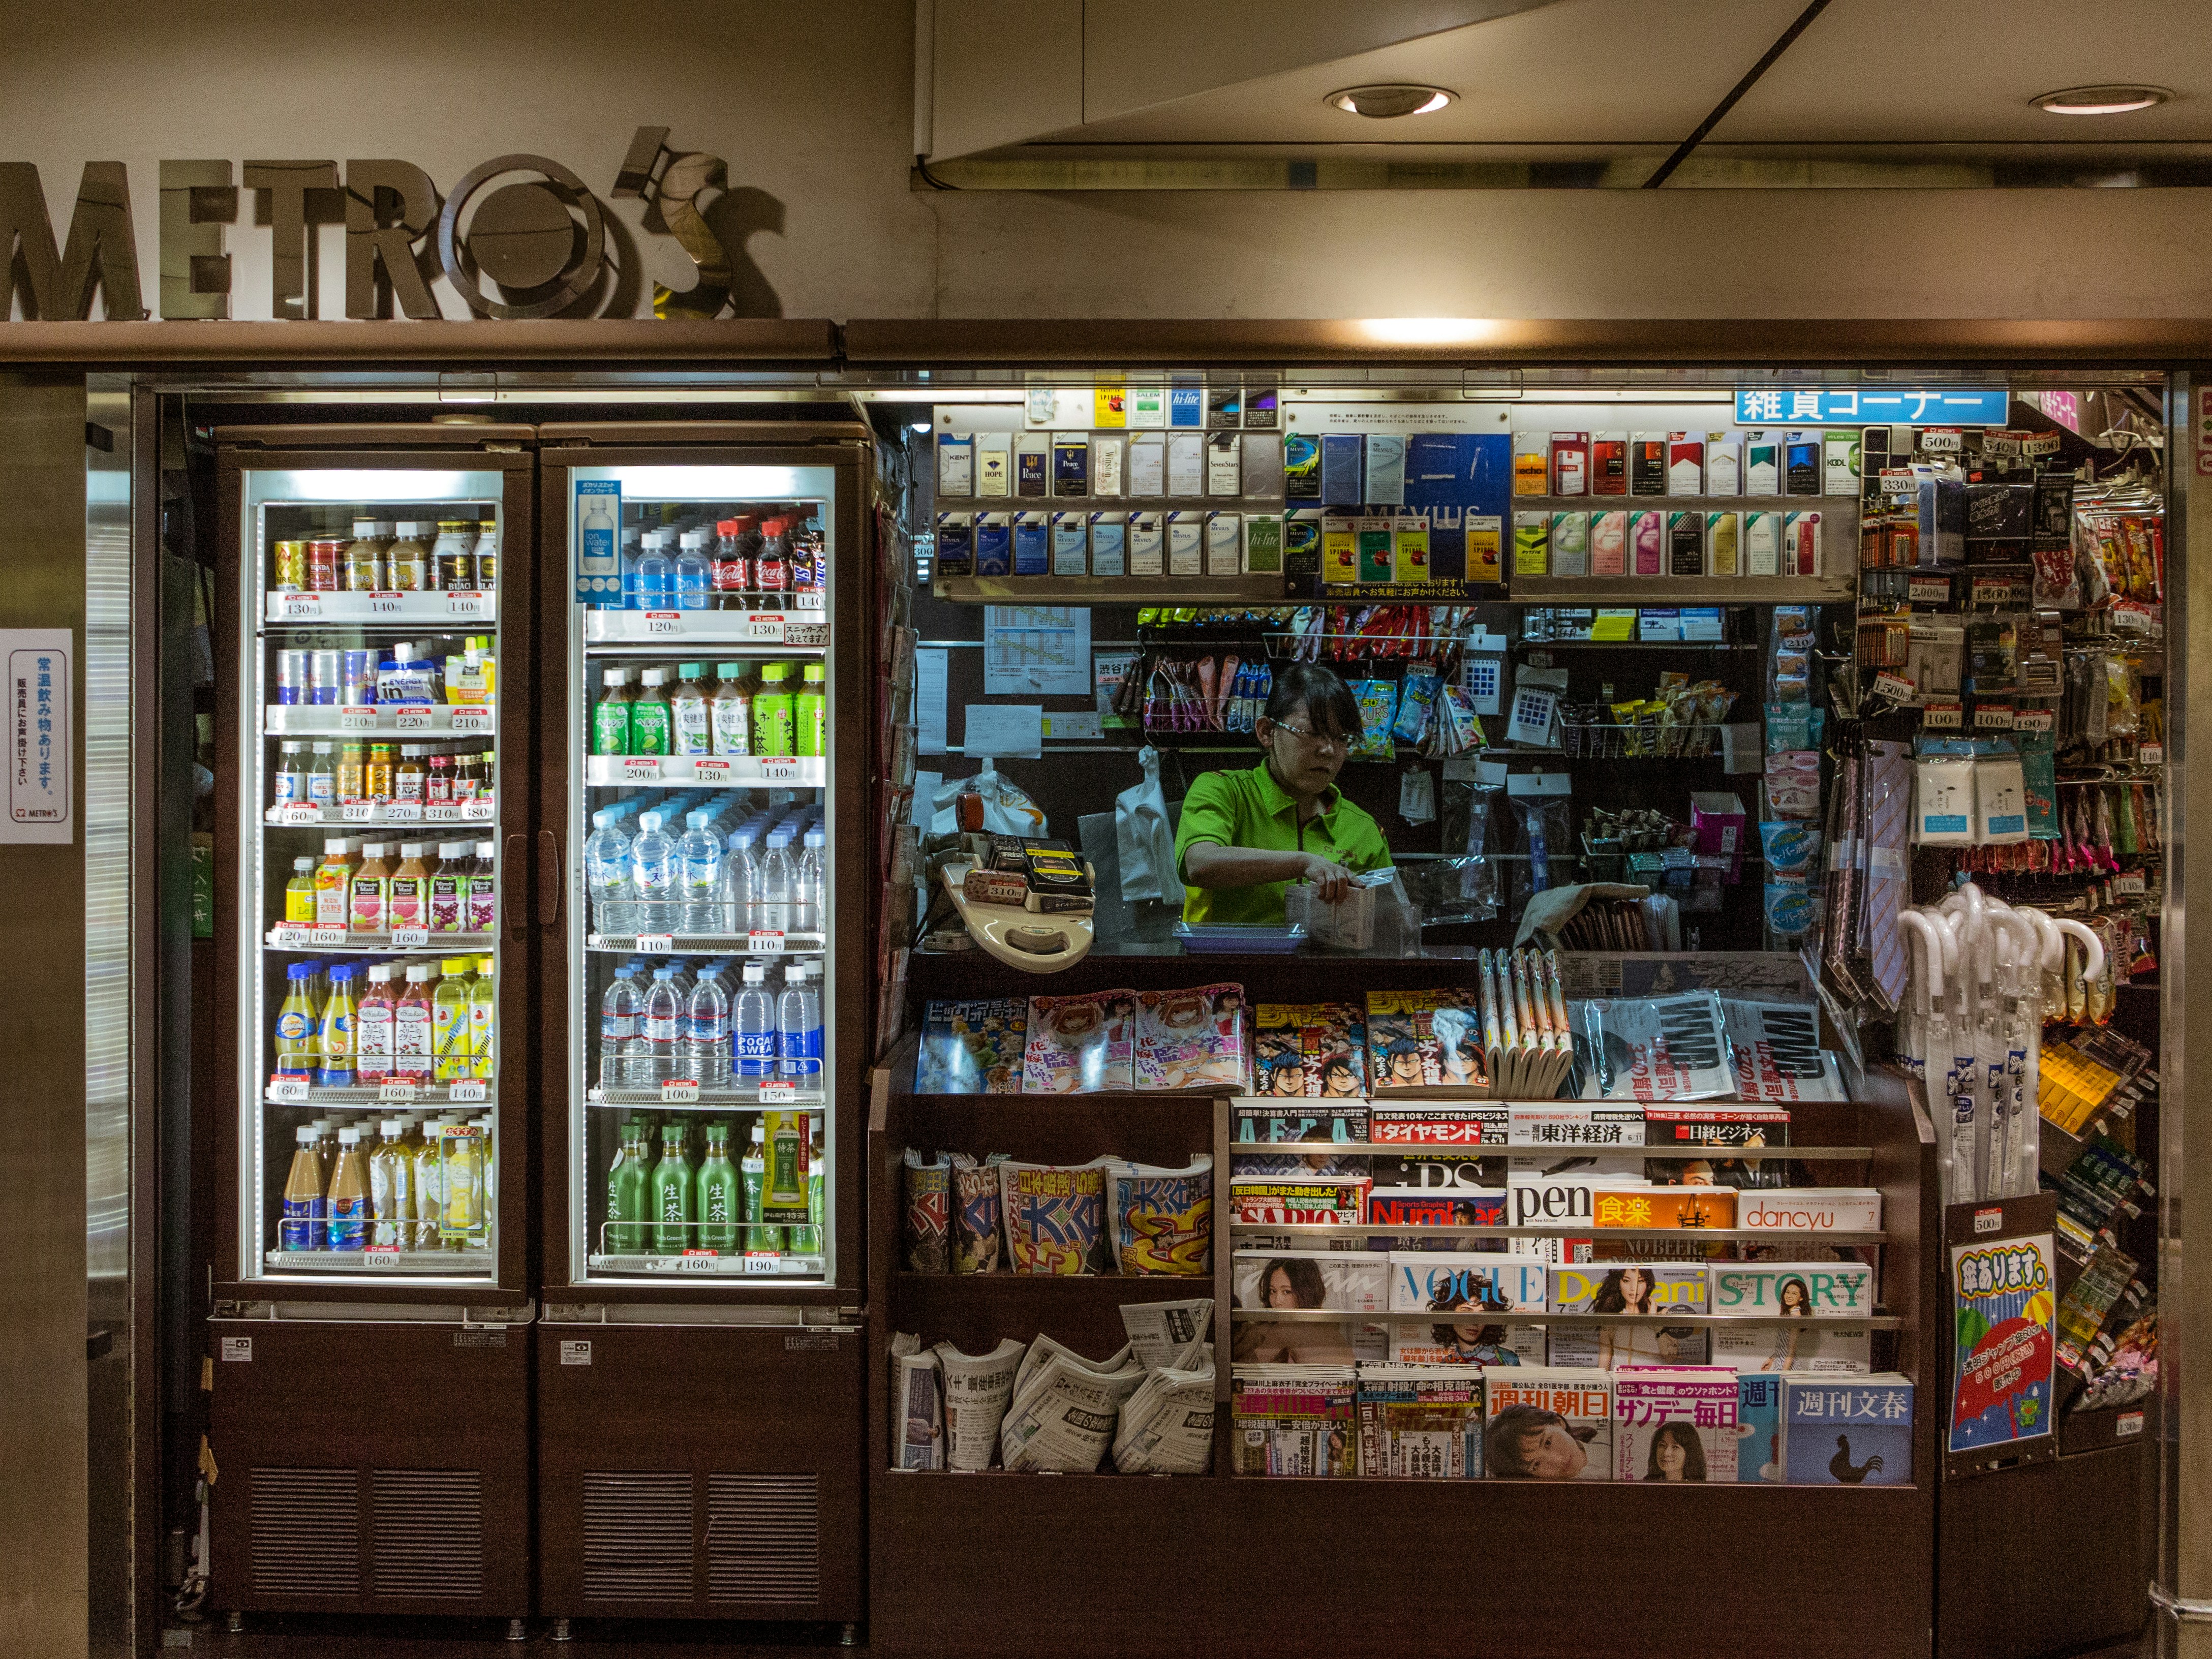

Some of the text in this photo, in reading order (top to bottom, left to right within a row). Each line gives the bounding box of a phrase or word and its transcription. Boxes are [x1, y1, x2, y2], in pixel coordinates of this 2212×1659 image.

[0, 126, 732, 321] METRO'S
[1173, 393, 1199, 405] hi-lite
[1744, 391, 1982, 420] 雑貨コーナー
[1925, 437, 1959, 448] 500円
[1105, 451, 1114, 478] Winston
[1827, 458, 1847, 467] KOOL
[1022, 468, 1041, 479] Peace
[1519, 466, 1542, 474] echo
[1884, 479, 1915, 490] 330円
[1249, 533, 1279, 545] hi-lite
[288, 604, 316, 615] 130円
[372, 602, 402, 612] 140円
[451, 602, 480, 612] 140円
[649, 622, 678, 632] 120円
[753, 625, 782, 635] 130円
[382, 682, 403, 699] in
[345, 717, 374, 727] 210円
[400, 717, 429, 727] 220円
[455, 718, 485, 728] 210円
[596, 719, 625, 727] ヘルシア
[635, 719, 663, 727] ヘルシア
[1927, 714, 1958, 725] 100円
[38, 657, 52, 795] 常温飲み物あります。
[627, 768, 658, 779] 200円
[698, 770, 727, 781] 130円
[765, 767, 795, 778] 140円
[388, 809, 417, 818] 270円
[429, 809, 458, 819] 310円
[991, 887, 1022, 897] 310円
[314, 932, 342, 941] 160円
[395, 933, 425, 943] 160円
[640, 941, 670, 951] 110円
[752, 940, 782, 950] 110円
[1658, 998, 1721, 1070] WWD
[383, 1088, 412, 1098] 160円
[454, 1089, 482, 1098] 140円
[666, 1090, 695, 1100] 100円
[763, 1091, 792, 1101] 150円
[446, 1127, 478, 1136] おすすめ
[1375, 1125, 1382, 1139] 週刊
[1382, 1123, 1480, 1141] ダイヤモンド
[1531, 1124, 1540, 1143] 週刊
[1540, 1123, 1623, 1144] 東洋経済
[1689, 1123, 1765, 1141] 日経ビジネス
[777, 1143, 795, 1153] 特茶
[1232, 1186, 1337, 1196] 「反日韓国」がまた動き出した!
[663, 1183, 684, 1222] 生茶
[709, 1183, 729, 1222] 生茶
[1134, 1179, 1193, 1216] 大谷
[1513, 1186, 1592, 1225] pen
[1597, 1195, 1652, 1223] 食楽
[1021, 1195, 1104, 1248] 大谷
[1747, 1201, 1834, 1231] dancyu
[1868, 1211, 1875, 1221] 7
[1625, 1239, 1703, 1256] NO BEER,
[368, 1255, 396, 1265] 160円
[685, 1259, 715, 1270] 160円
[748, 1261, 778, 1272] 190円
[1962, 1250, 2044, 1294] 傘あります。
[1400, 1266, 1544, 1304] VOGUE
[1718, 1273, 1867, 1307] STORY
[1740, 1287, 1747, 1299] 7
[1557, 1304, 1566, 1313] 7
[1993, 1367, 2021, 1392] 販売中
[1490, 1390, 1608, 1417] 週刊朝日
[1797, 1390, 1909, 1419] 週刊文春
[1616, 1399, 1737, 1429] サンデー毎日
